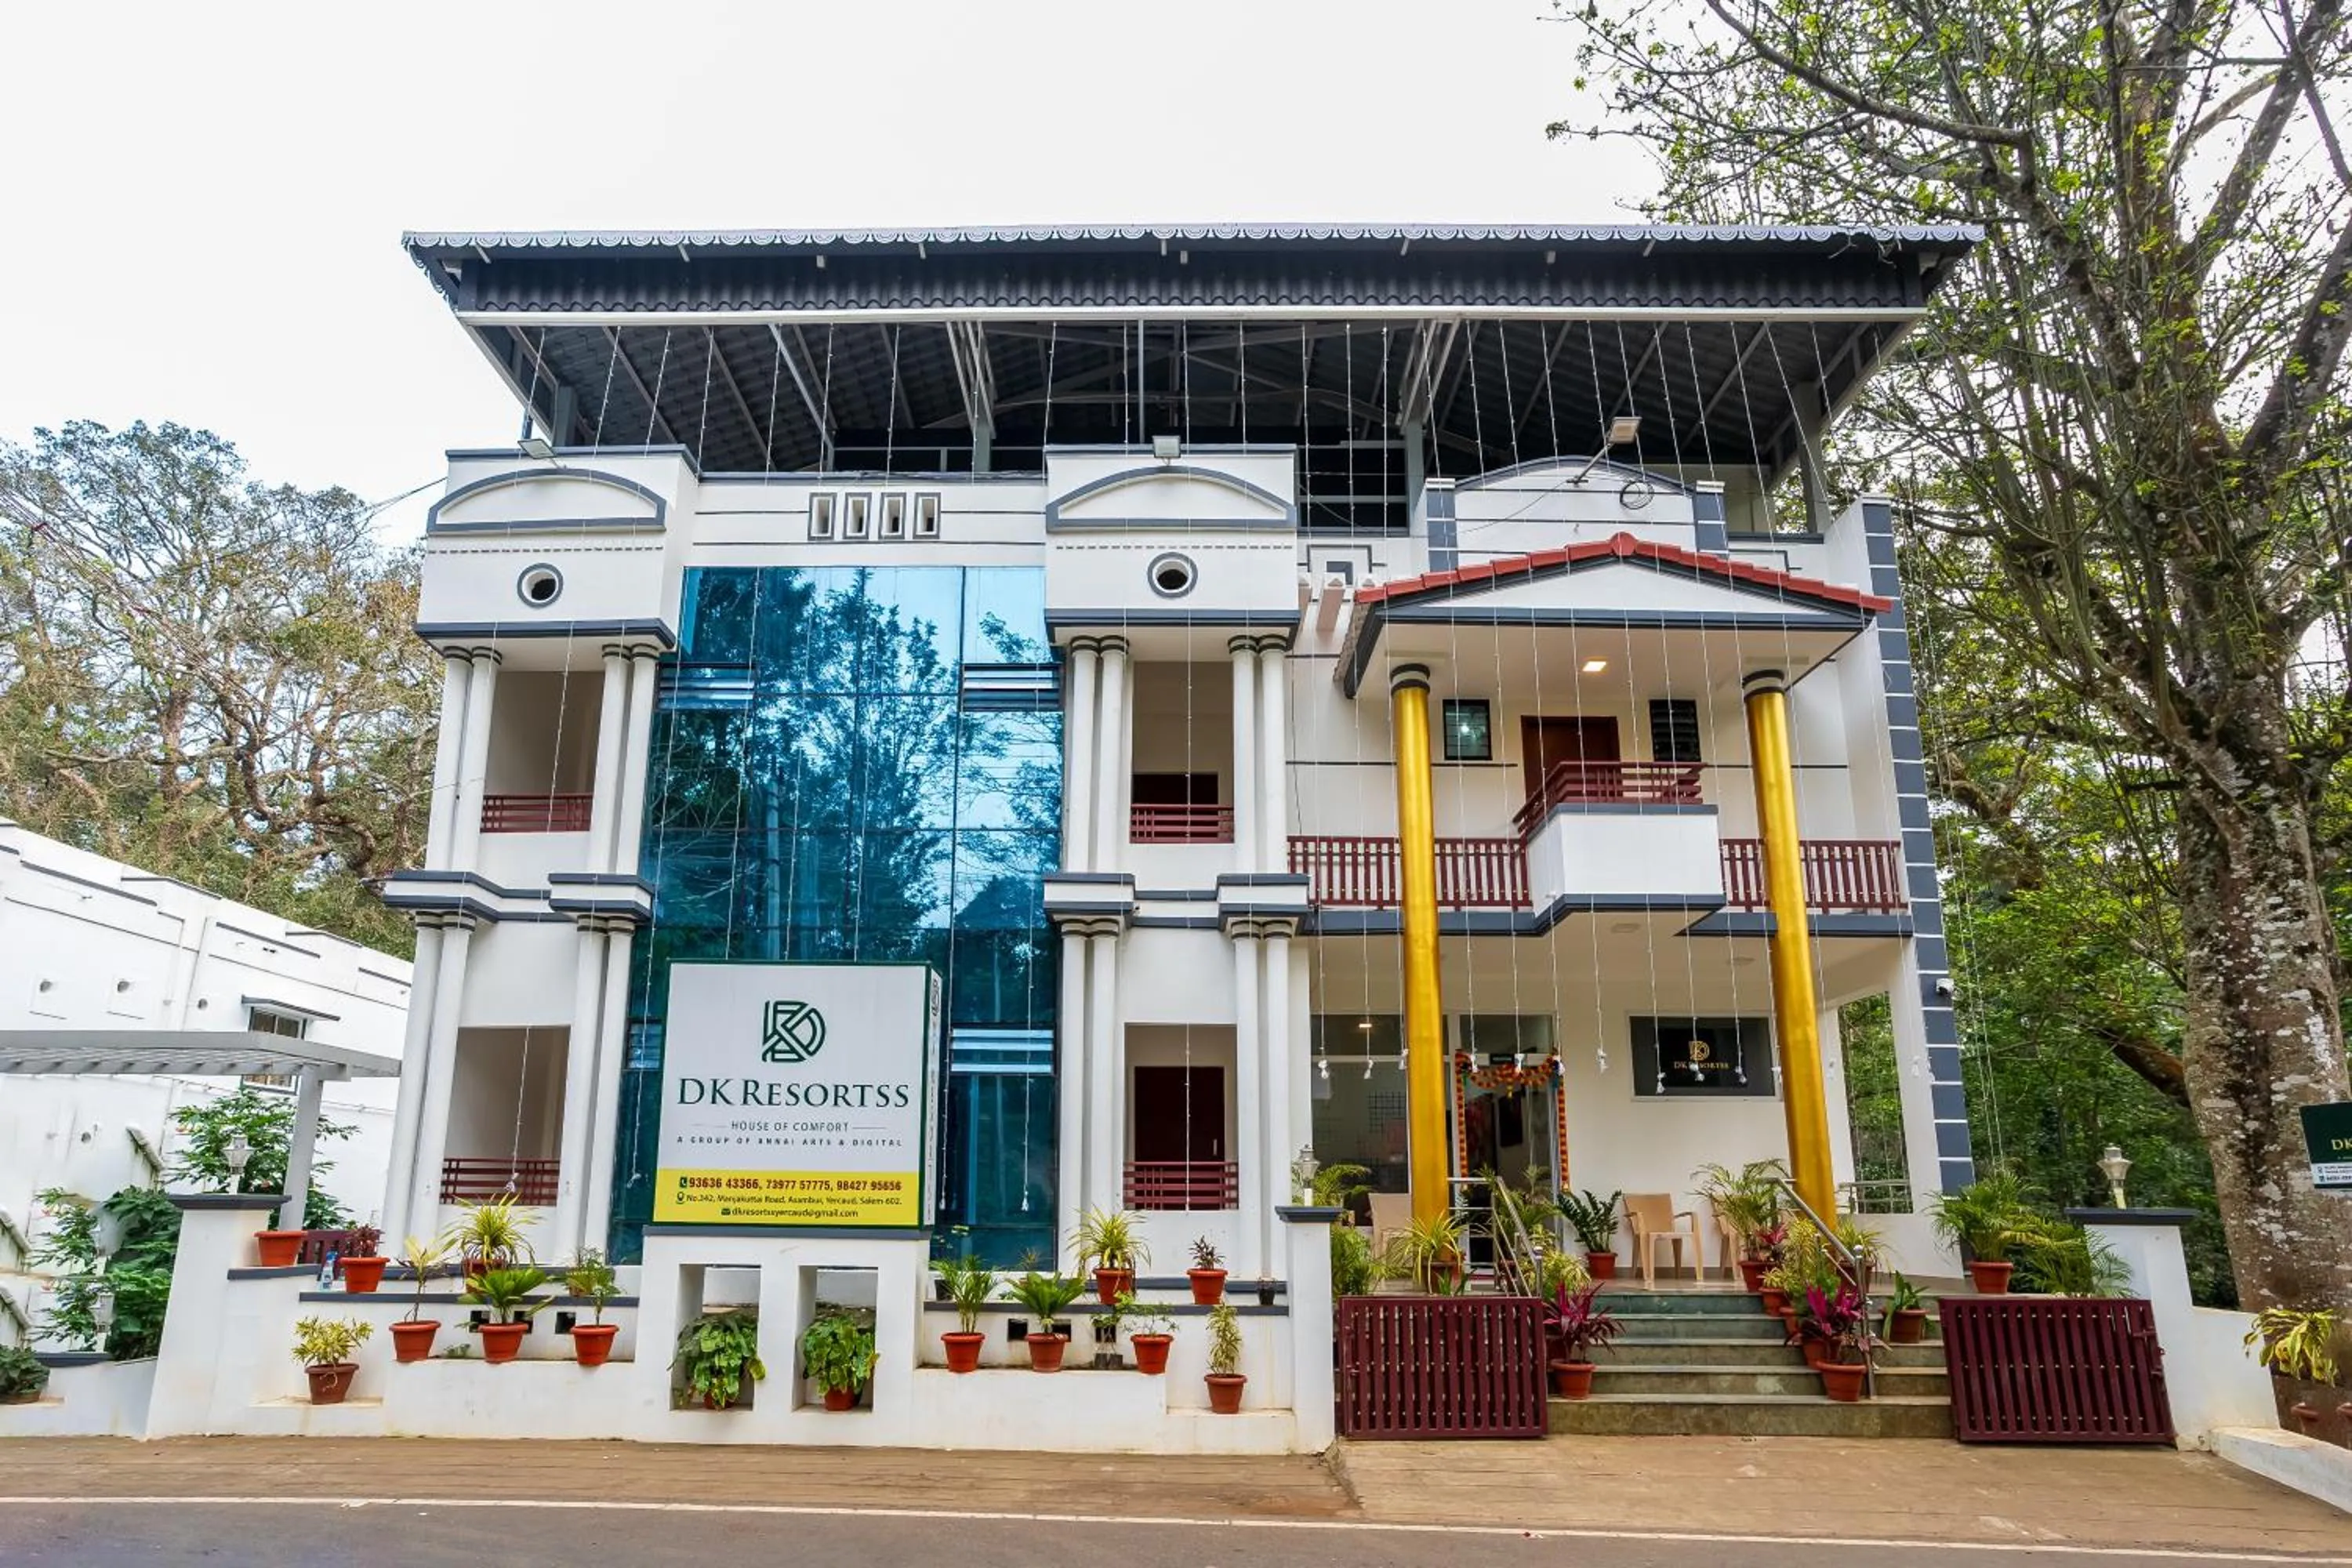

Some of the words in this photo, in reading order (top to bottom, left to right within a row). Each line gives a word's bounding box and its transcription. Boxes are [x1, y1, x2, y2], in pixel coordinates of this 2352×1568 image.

[677, 1078, 734, 1105] DK
[741, 1079, 909, 1108] RESORTSS
[731, 1120, 769, 1131] HOUSE
[774, 1122, 789, 1131] OF
[793, 1122, 848, 1132] COMFORT
[689, 1177, 722, 1188] 93636
[725, 1178, 762, 1191] 43366,
[766, 1179, 797, 1189] 73977
[800, 1180, 833, 1192] 57775,
[837, 1180, 868, 1190] 98427
